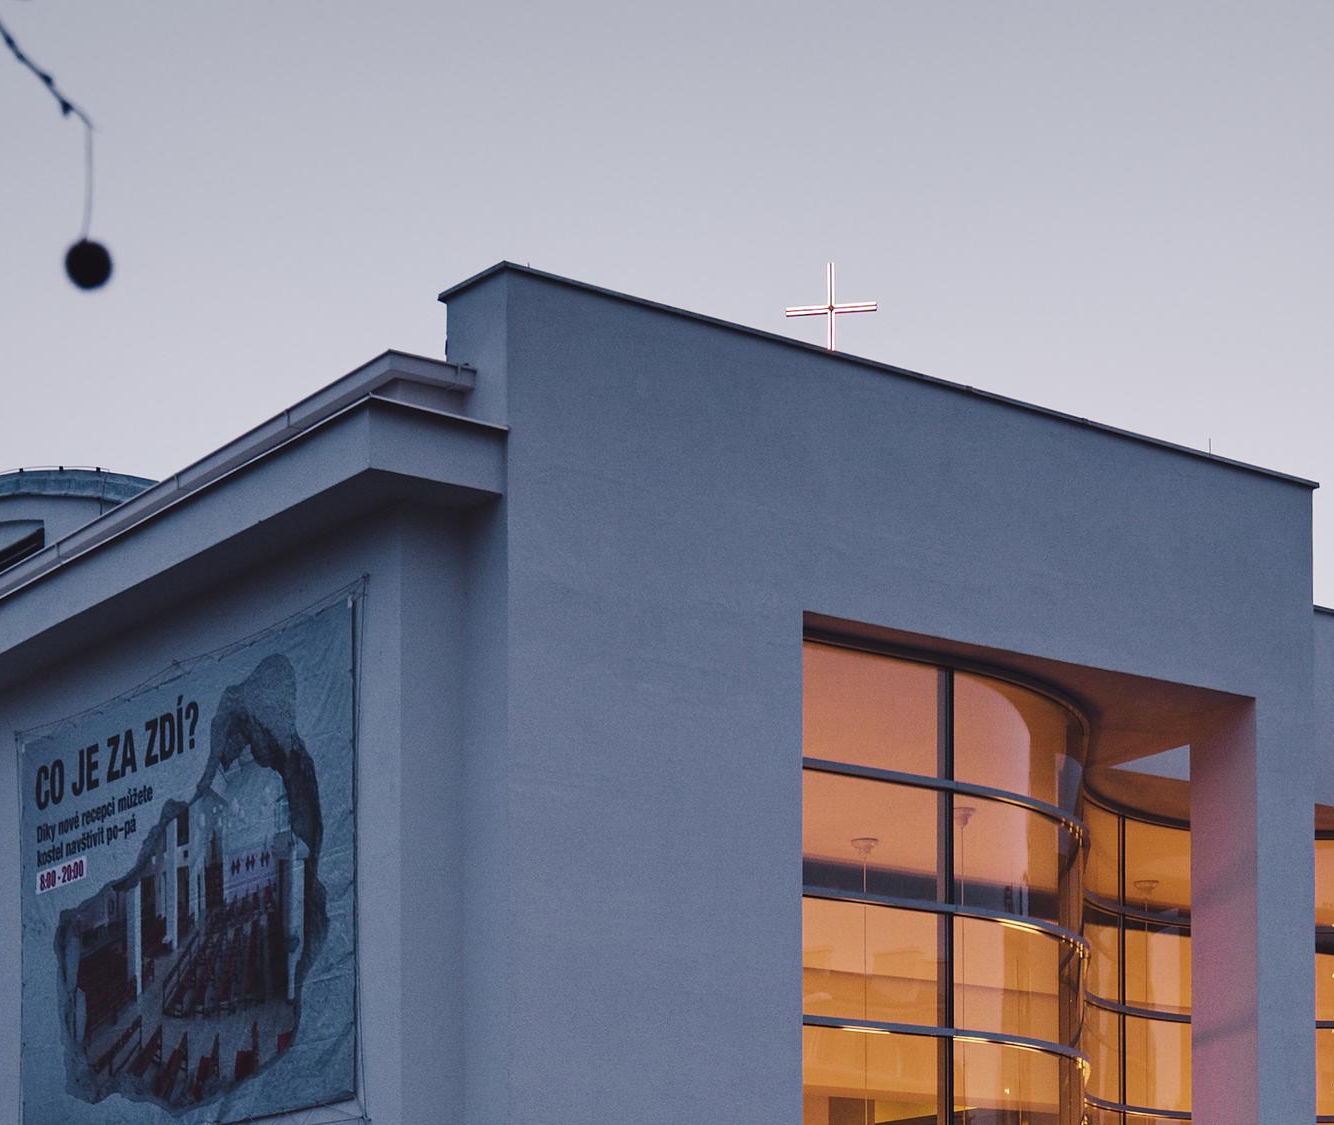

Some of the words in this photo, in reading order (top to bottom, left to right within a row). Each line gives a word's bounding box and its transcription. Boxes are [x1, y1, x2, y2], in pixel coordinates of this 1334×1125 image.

[36, 759, 65, 811] CO
[72, 743, 99, 796] JE
[107, 729, 137, 783] ZA
[145, 695, 199, 768] ZDÍ?
[59, 810, 80, 835] nové
[118, 785, 153, 813] můžete
[37, 841, 64, 868] kostel
[107, 813, 137, 846] po-pá
[40, 870, 57, 891] 8:00
[62, 859, 84, 883] 20:00
